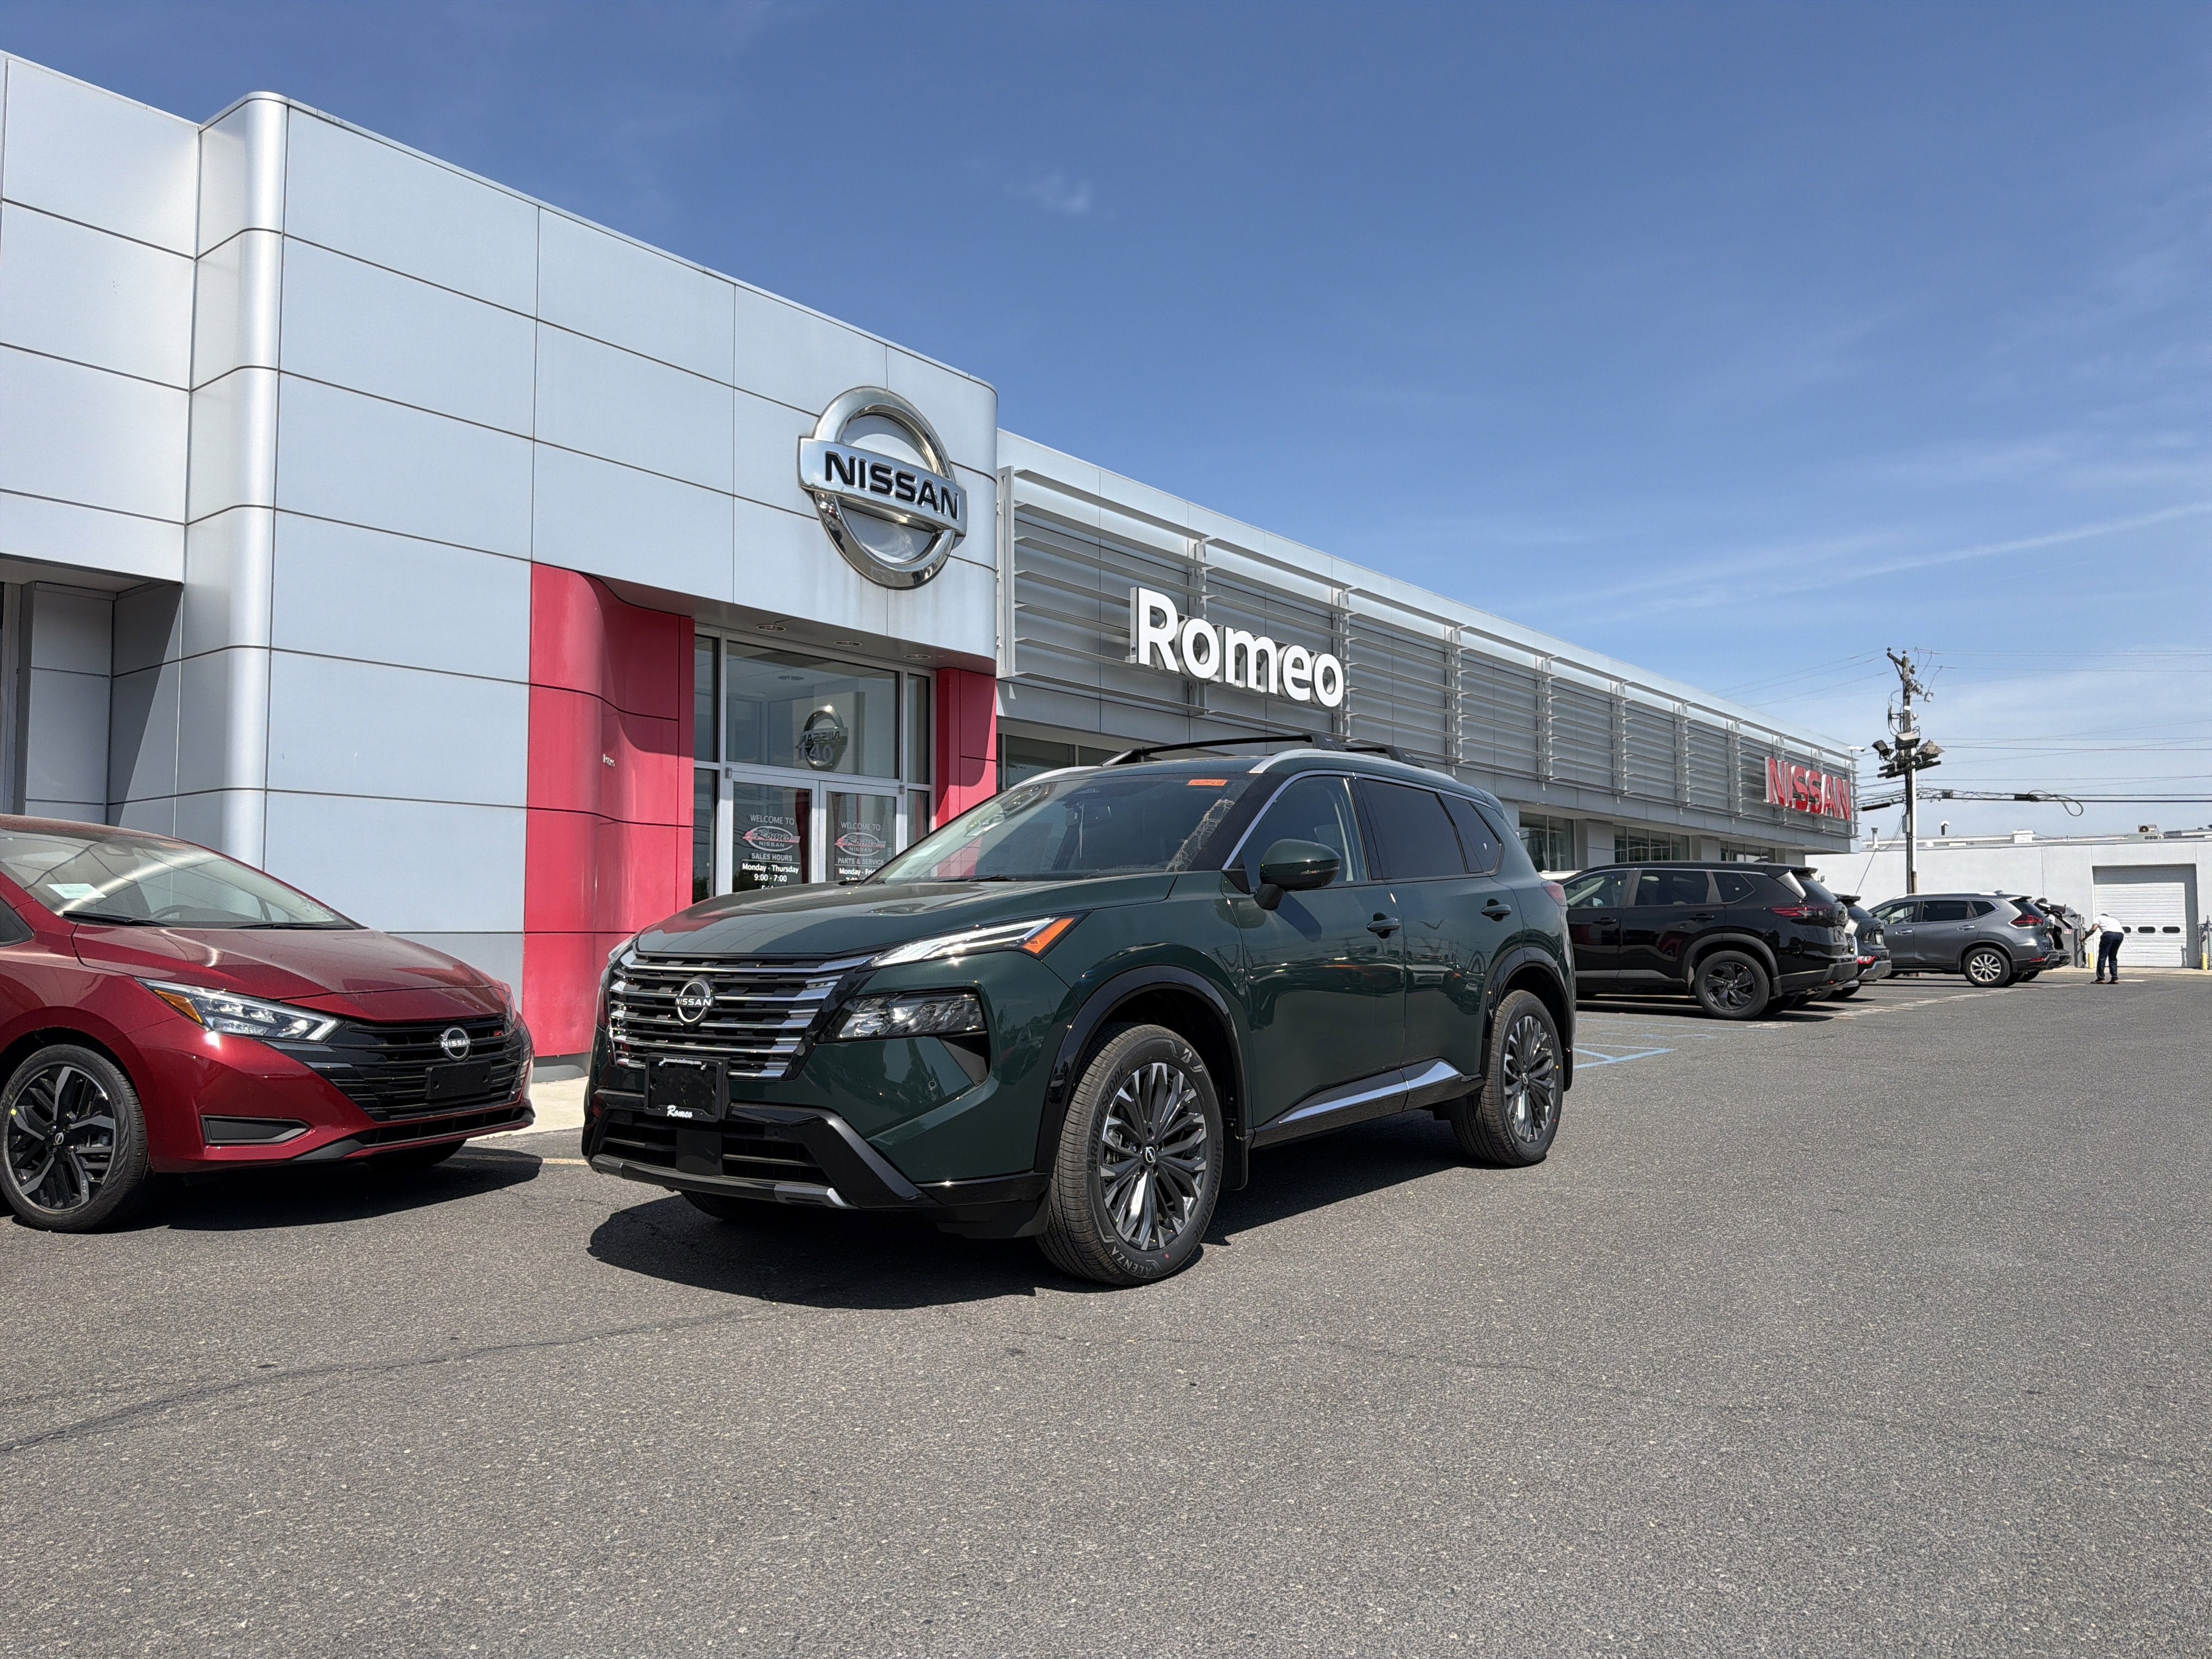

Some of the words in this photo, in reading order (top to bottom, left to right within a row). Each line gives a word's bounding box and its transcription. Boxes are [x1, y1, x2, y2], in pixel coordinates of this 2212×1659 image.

[825, 451, 959, 520] NISSAN
[1130, 586, 1344, 707] Romeo
[798, 741, 833, 760] 140
[1765, 757, 1851, 821] NISSAN
[750, 814, 783, 824] WELCOME
[785, 817, 795, 825] TO
[841, 821, 871, 831] WELCOME
[755, 827, 792, 841] Romeo
[845, 834, 878, 847] Romeo
[742, 863, 767, 872] Monday
[771, 864, 799, 874] Thursday
[839, 867, 861, 876] Monday
[676, 998, 712, 1006] NISSAN
[441, 1039, 471, 1047] NISSAN
[667, 1105, 693, 1118] Romeo
[1111, 1245, 1152, 1275] ALENZA
